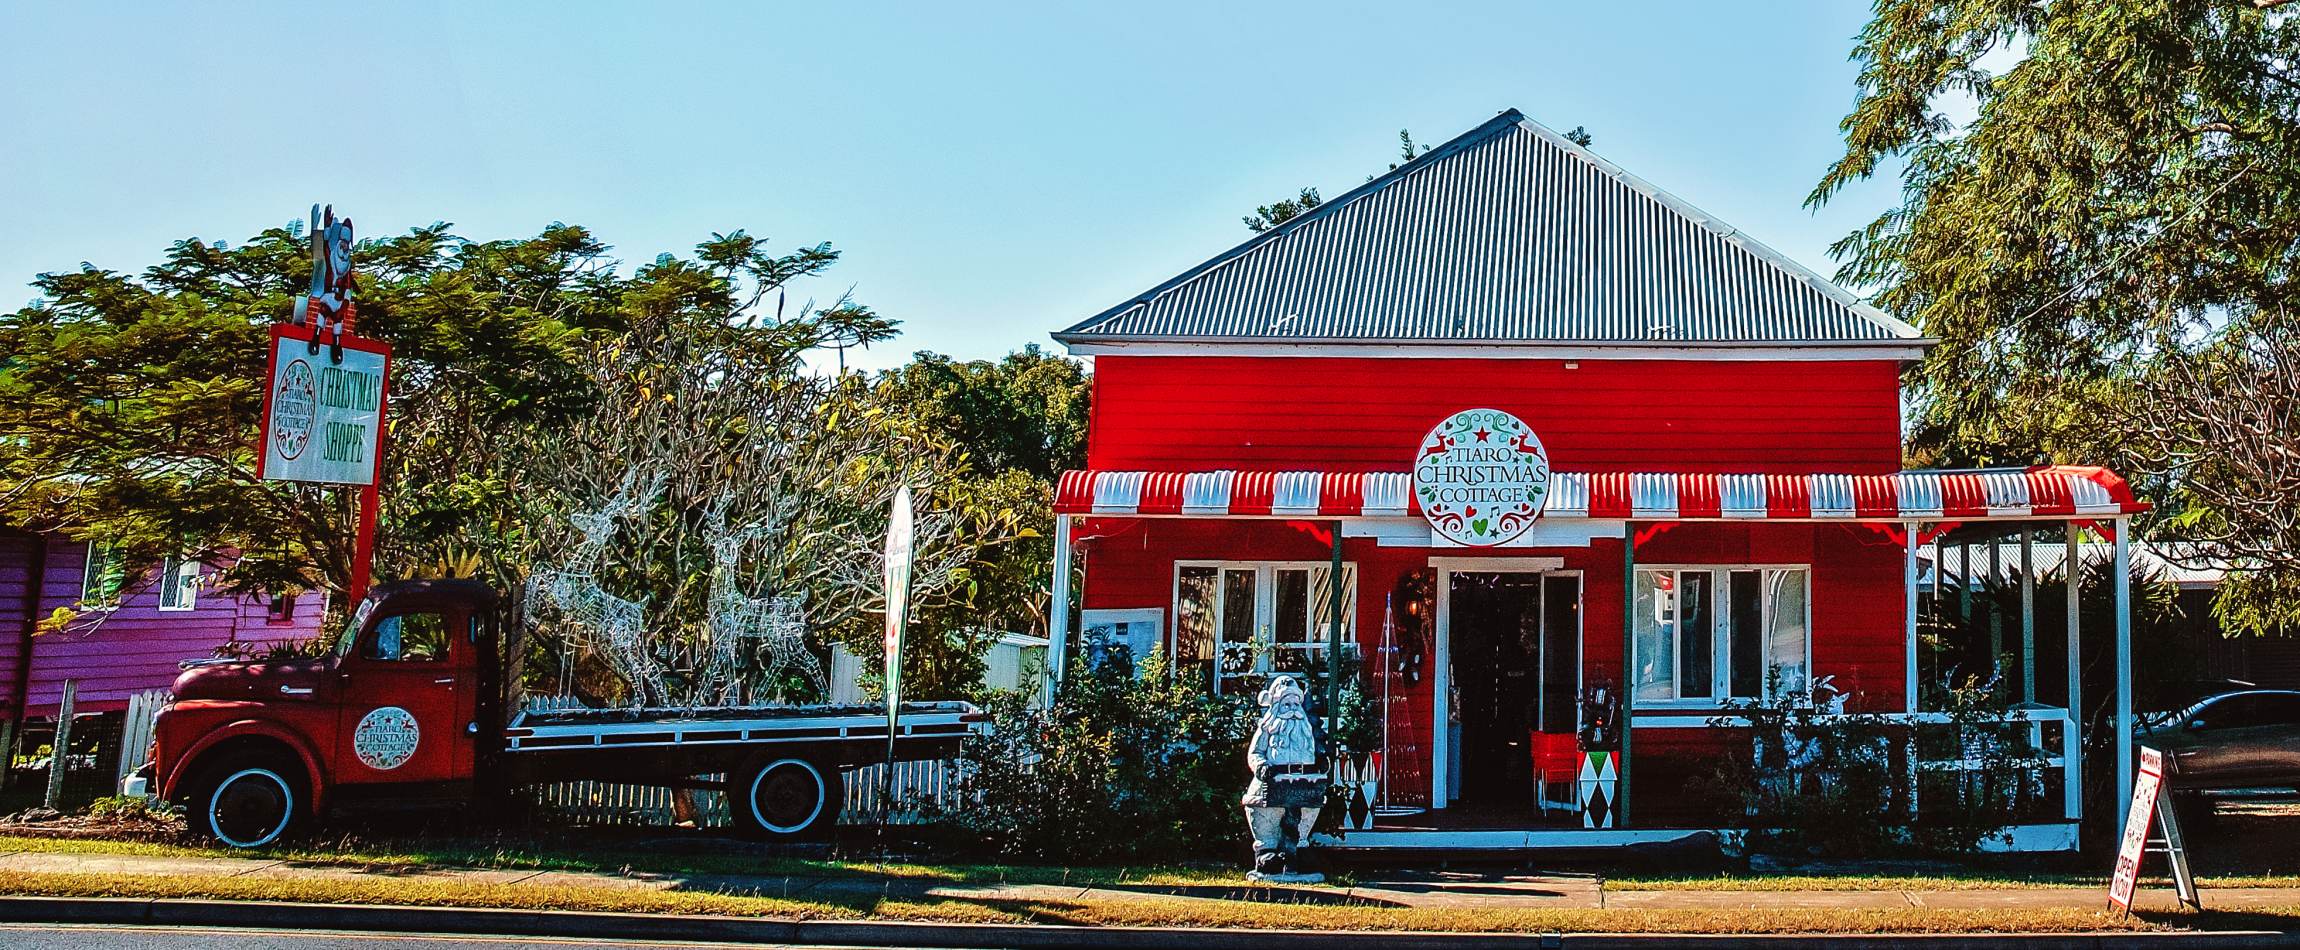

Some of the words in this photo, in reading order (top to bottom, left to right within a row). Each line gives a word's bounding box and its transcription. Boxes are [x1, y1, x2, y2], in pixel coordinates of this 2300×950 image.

[320, 367, 380, 412] CHRISTMAS
[276, 400, 313, 416] CHRISTMAS
[323, 421, 366, 463] SHOPPE
[1453, 447, 1512, 463] TIARO
[1417, 465, 1547, 486] CHRISTMAS
[1440, 487, 1524, 503] COTTAGE
[374, 725, 402, 733] TIARO
[356, 733, 417, 743] CHRISTMAS
[366, 743, 405, 751] COTTAGE
[2117, 855, 2136, 880] OPEN
[2113, 877, 2129, 900] NOW
